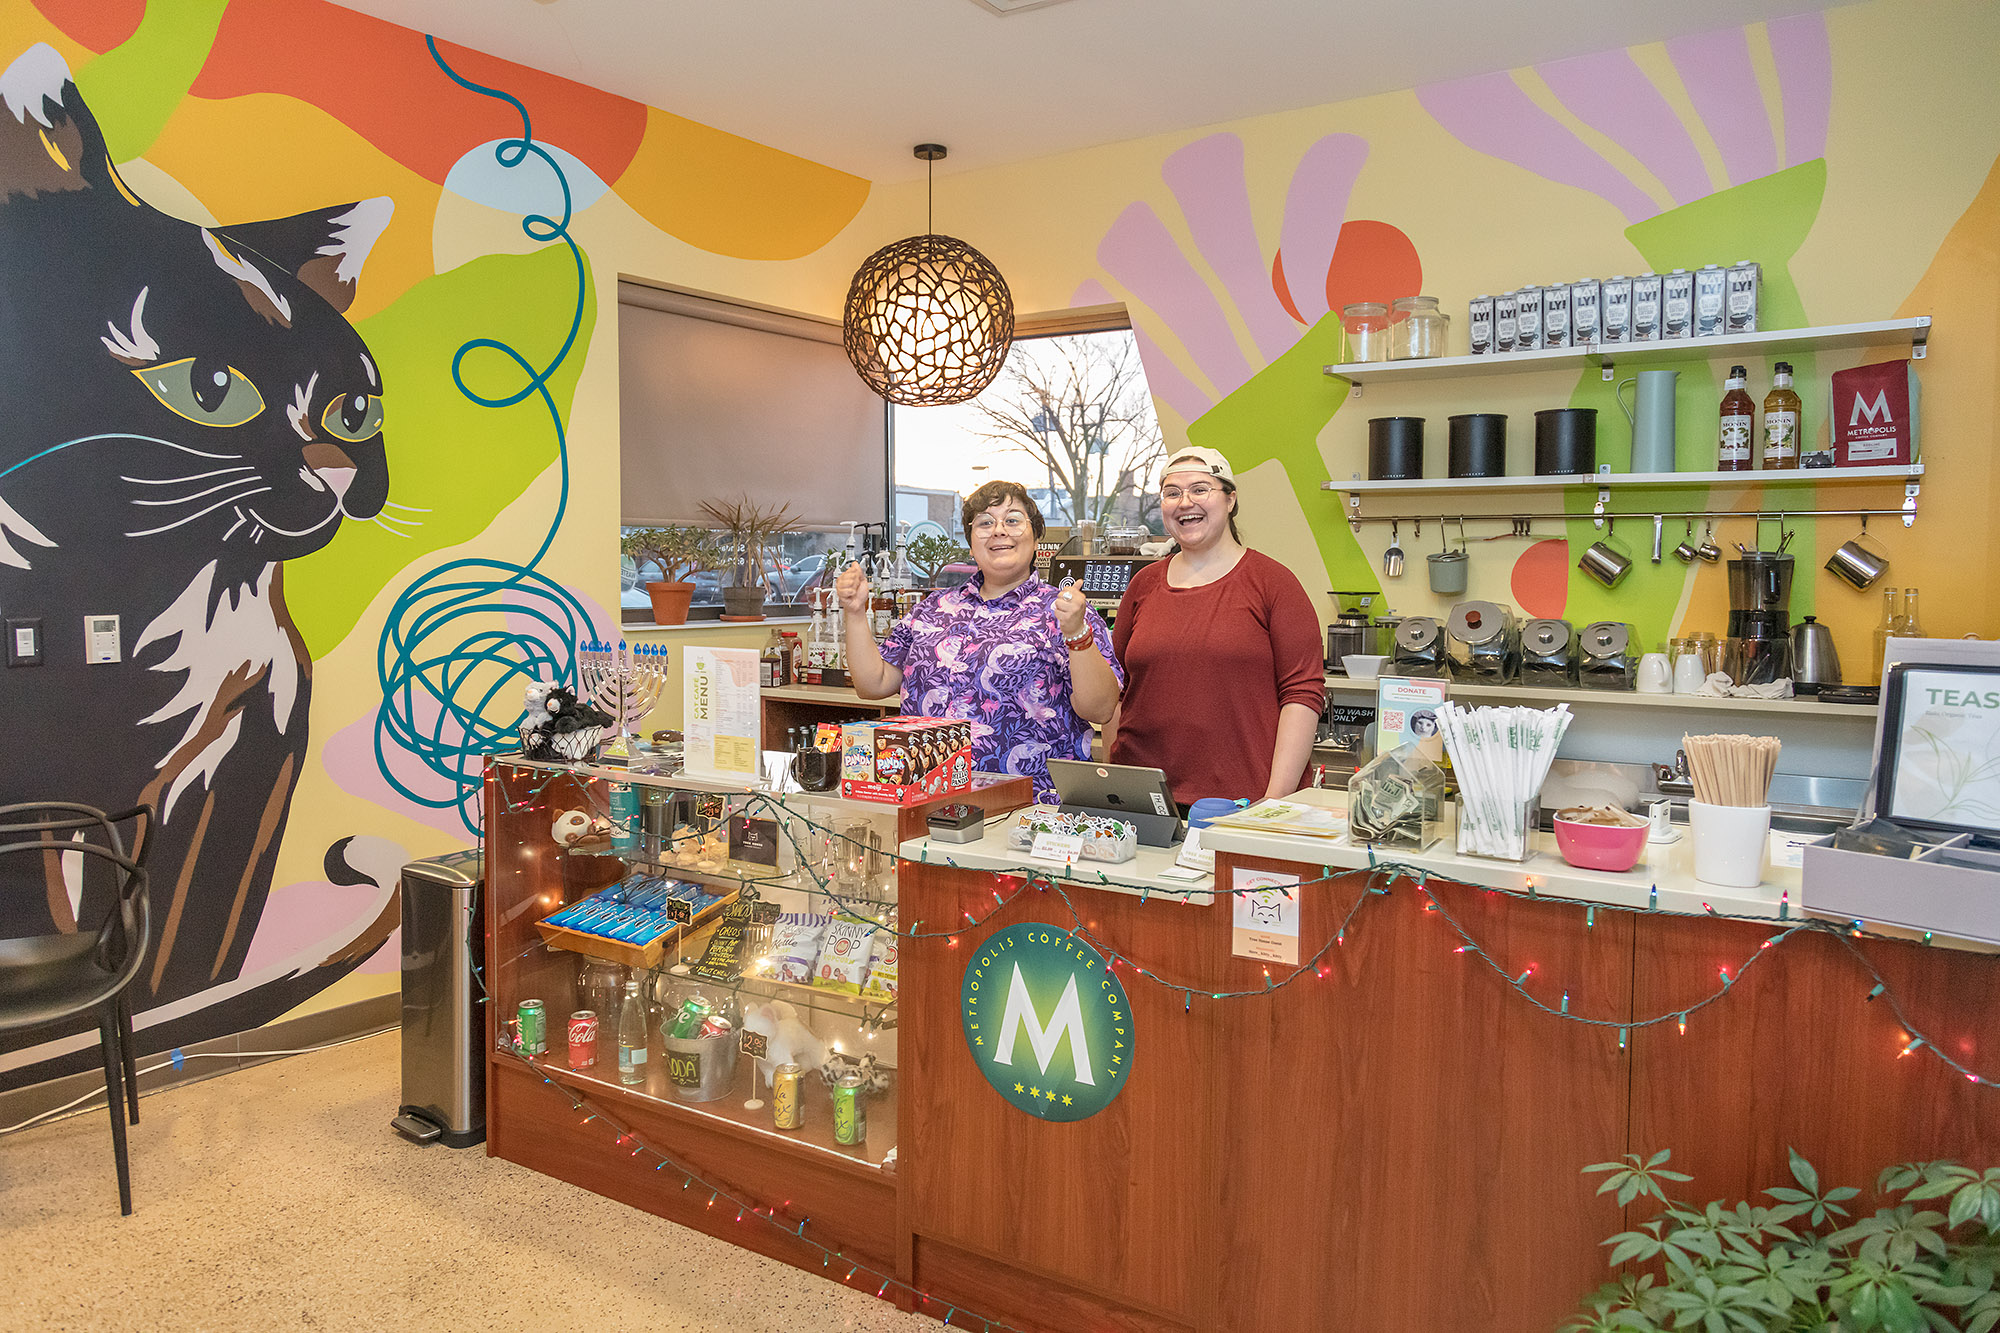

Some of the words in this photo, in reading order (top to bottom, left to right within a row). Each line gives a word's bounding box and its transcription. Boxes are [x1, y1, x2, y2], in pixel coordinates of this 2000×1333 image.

[1849, 389, 1893, 426] M
[1847, 426, 1897, 436] METROPOLIS
[700, 676, 709, 720] MENU
[1397, 687, 1427, 695] DONATE
[1926, 688, 2000, 709] TEAS
[1333, 714, 1357, 722] ONLY
[1347, 709, 1374, 717] WASH
[845, 753, 871, 768] PANDA
[876, 757, 905, 770] PANDA
[831, 923, 868, 938] SKINNY
[825, 935, 860, 957] POP
[823, 955, 855, 965] POPCORN
[969, 937, 1014, 1046] METROPOLIS
[1028, 932, 1095, 970] COFFEE
[1101, 980, 1124, 1079] COMPANY
[993, 960, 1096, 1086] M
[568, 1022, 599, 1043] Cola
[665, 1058, 696, 1078] ODA
